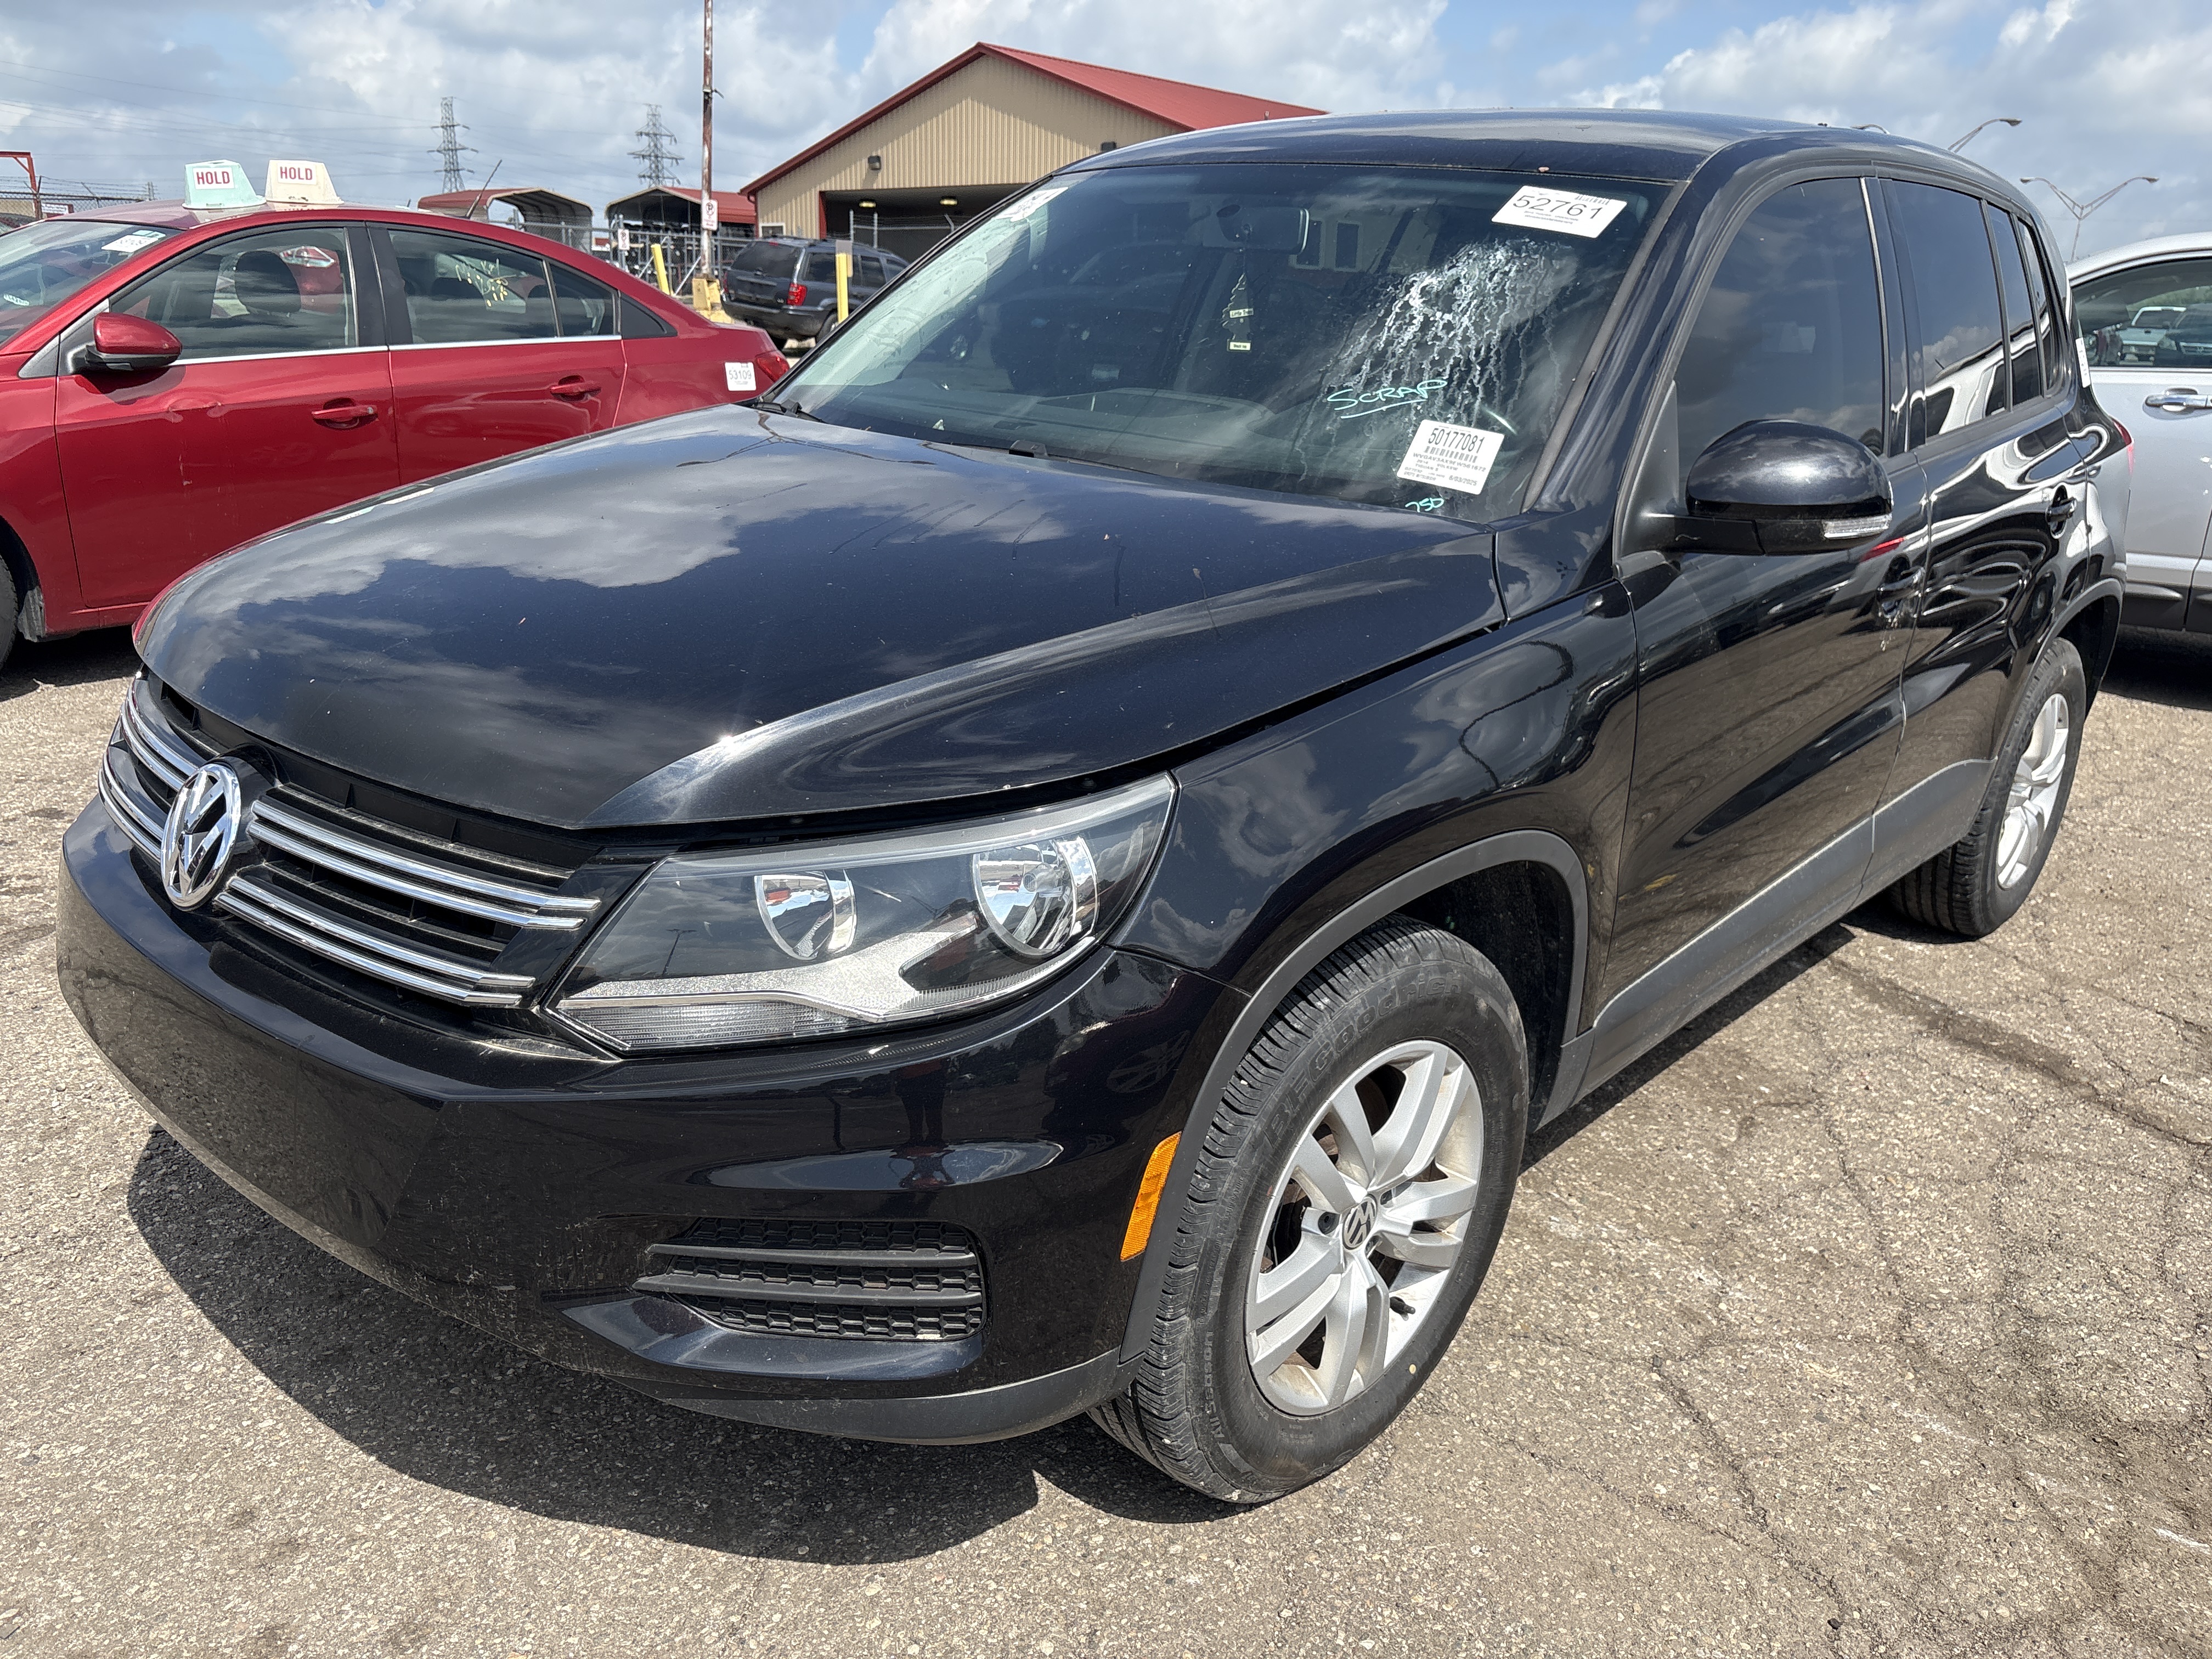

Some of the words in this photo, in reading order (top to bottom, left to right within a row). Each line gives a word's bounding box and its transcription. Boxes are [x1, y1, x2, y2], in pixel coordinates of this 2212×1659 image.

[196, 171, 230, 185] HOLD
[280, 166, 313, 180] HOLD
[1513, 195, 1603, 219] 52761
[729, 369, 752, 380] 53109
[1327, 379, 1448, 411] SCRAP
[1427, 427, 1486, 454] 50177081
[163, 765, 237, 906] VW
